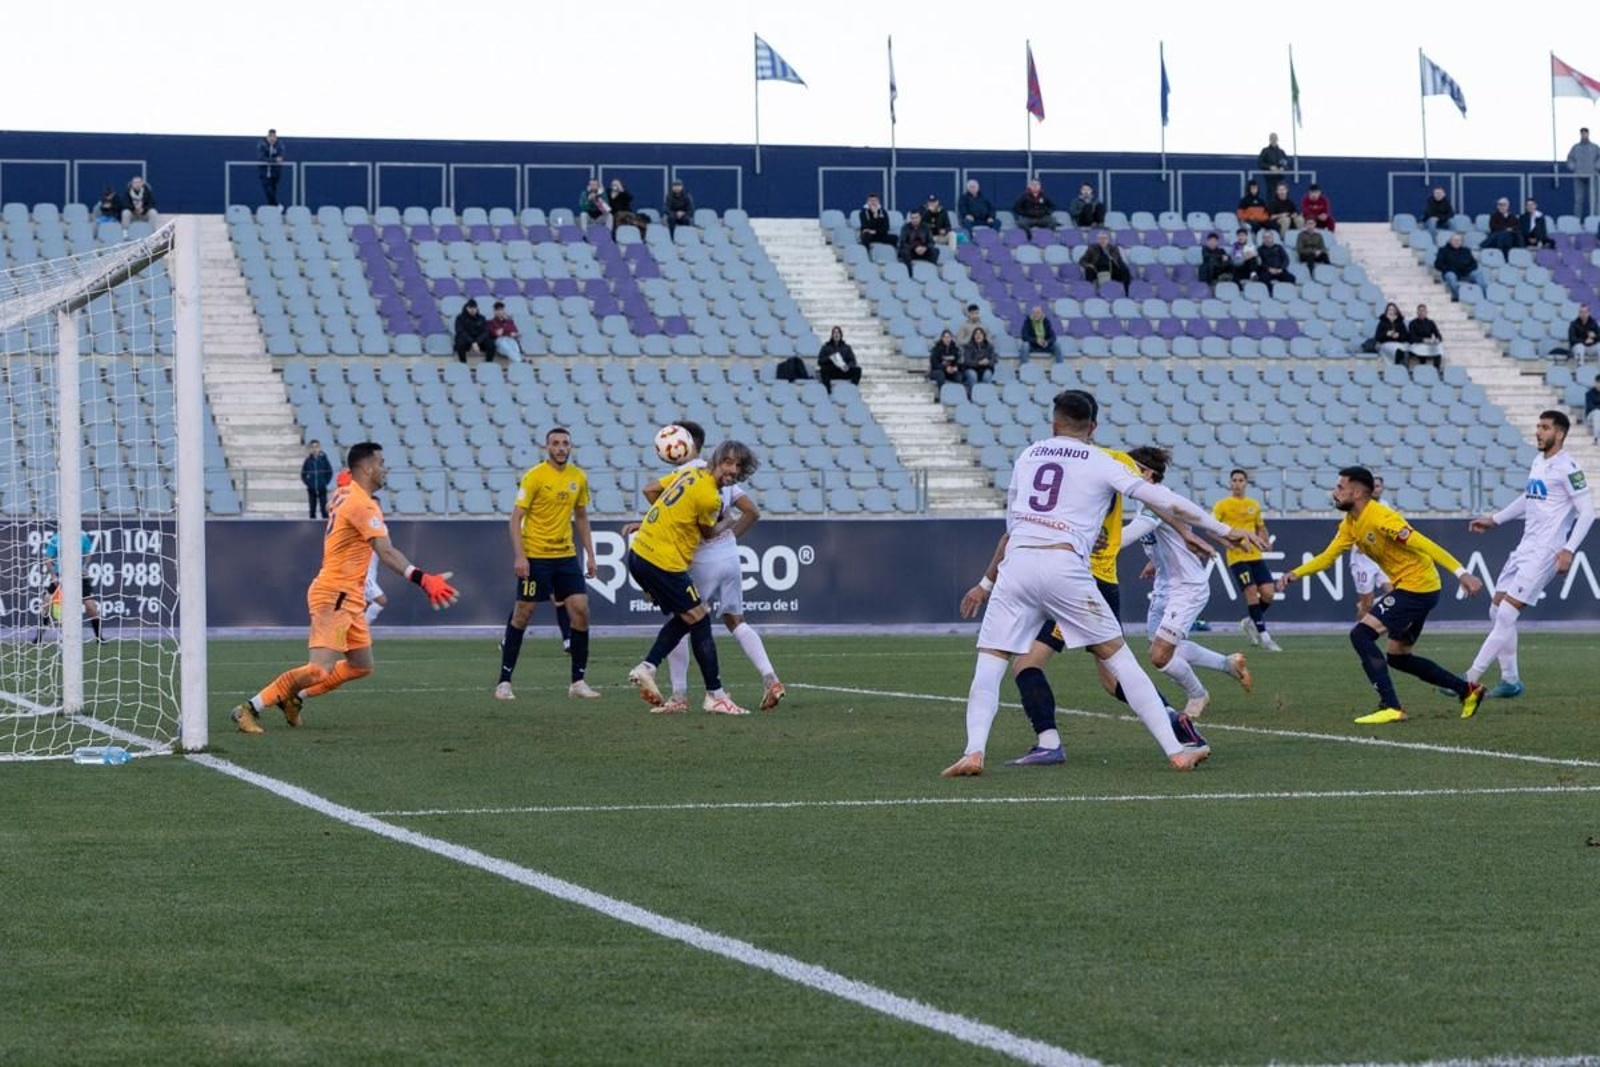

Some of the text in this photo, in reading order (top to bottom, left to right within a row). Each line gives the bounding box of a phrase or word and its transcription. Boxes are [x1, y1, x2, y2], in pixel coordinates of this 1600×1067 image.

[1030, 446, 1089, 460] FERNANDO
[1029, 463, 1064, 512] 9
[88, 531, 112, 553] 71
[124, 531, 160, 553] 104
[88, 563, 115, 586] 98
[123, 563, 161, 586] 988
[1239, 571, 1251, 585] 17
[1356, 571, 1368, 583] 10
[522, 581, 536, 597] 18
[138, 597, 159, 613] 76
[773, 599, 789, 611] de
[791, 599, 798, 611] ti
